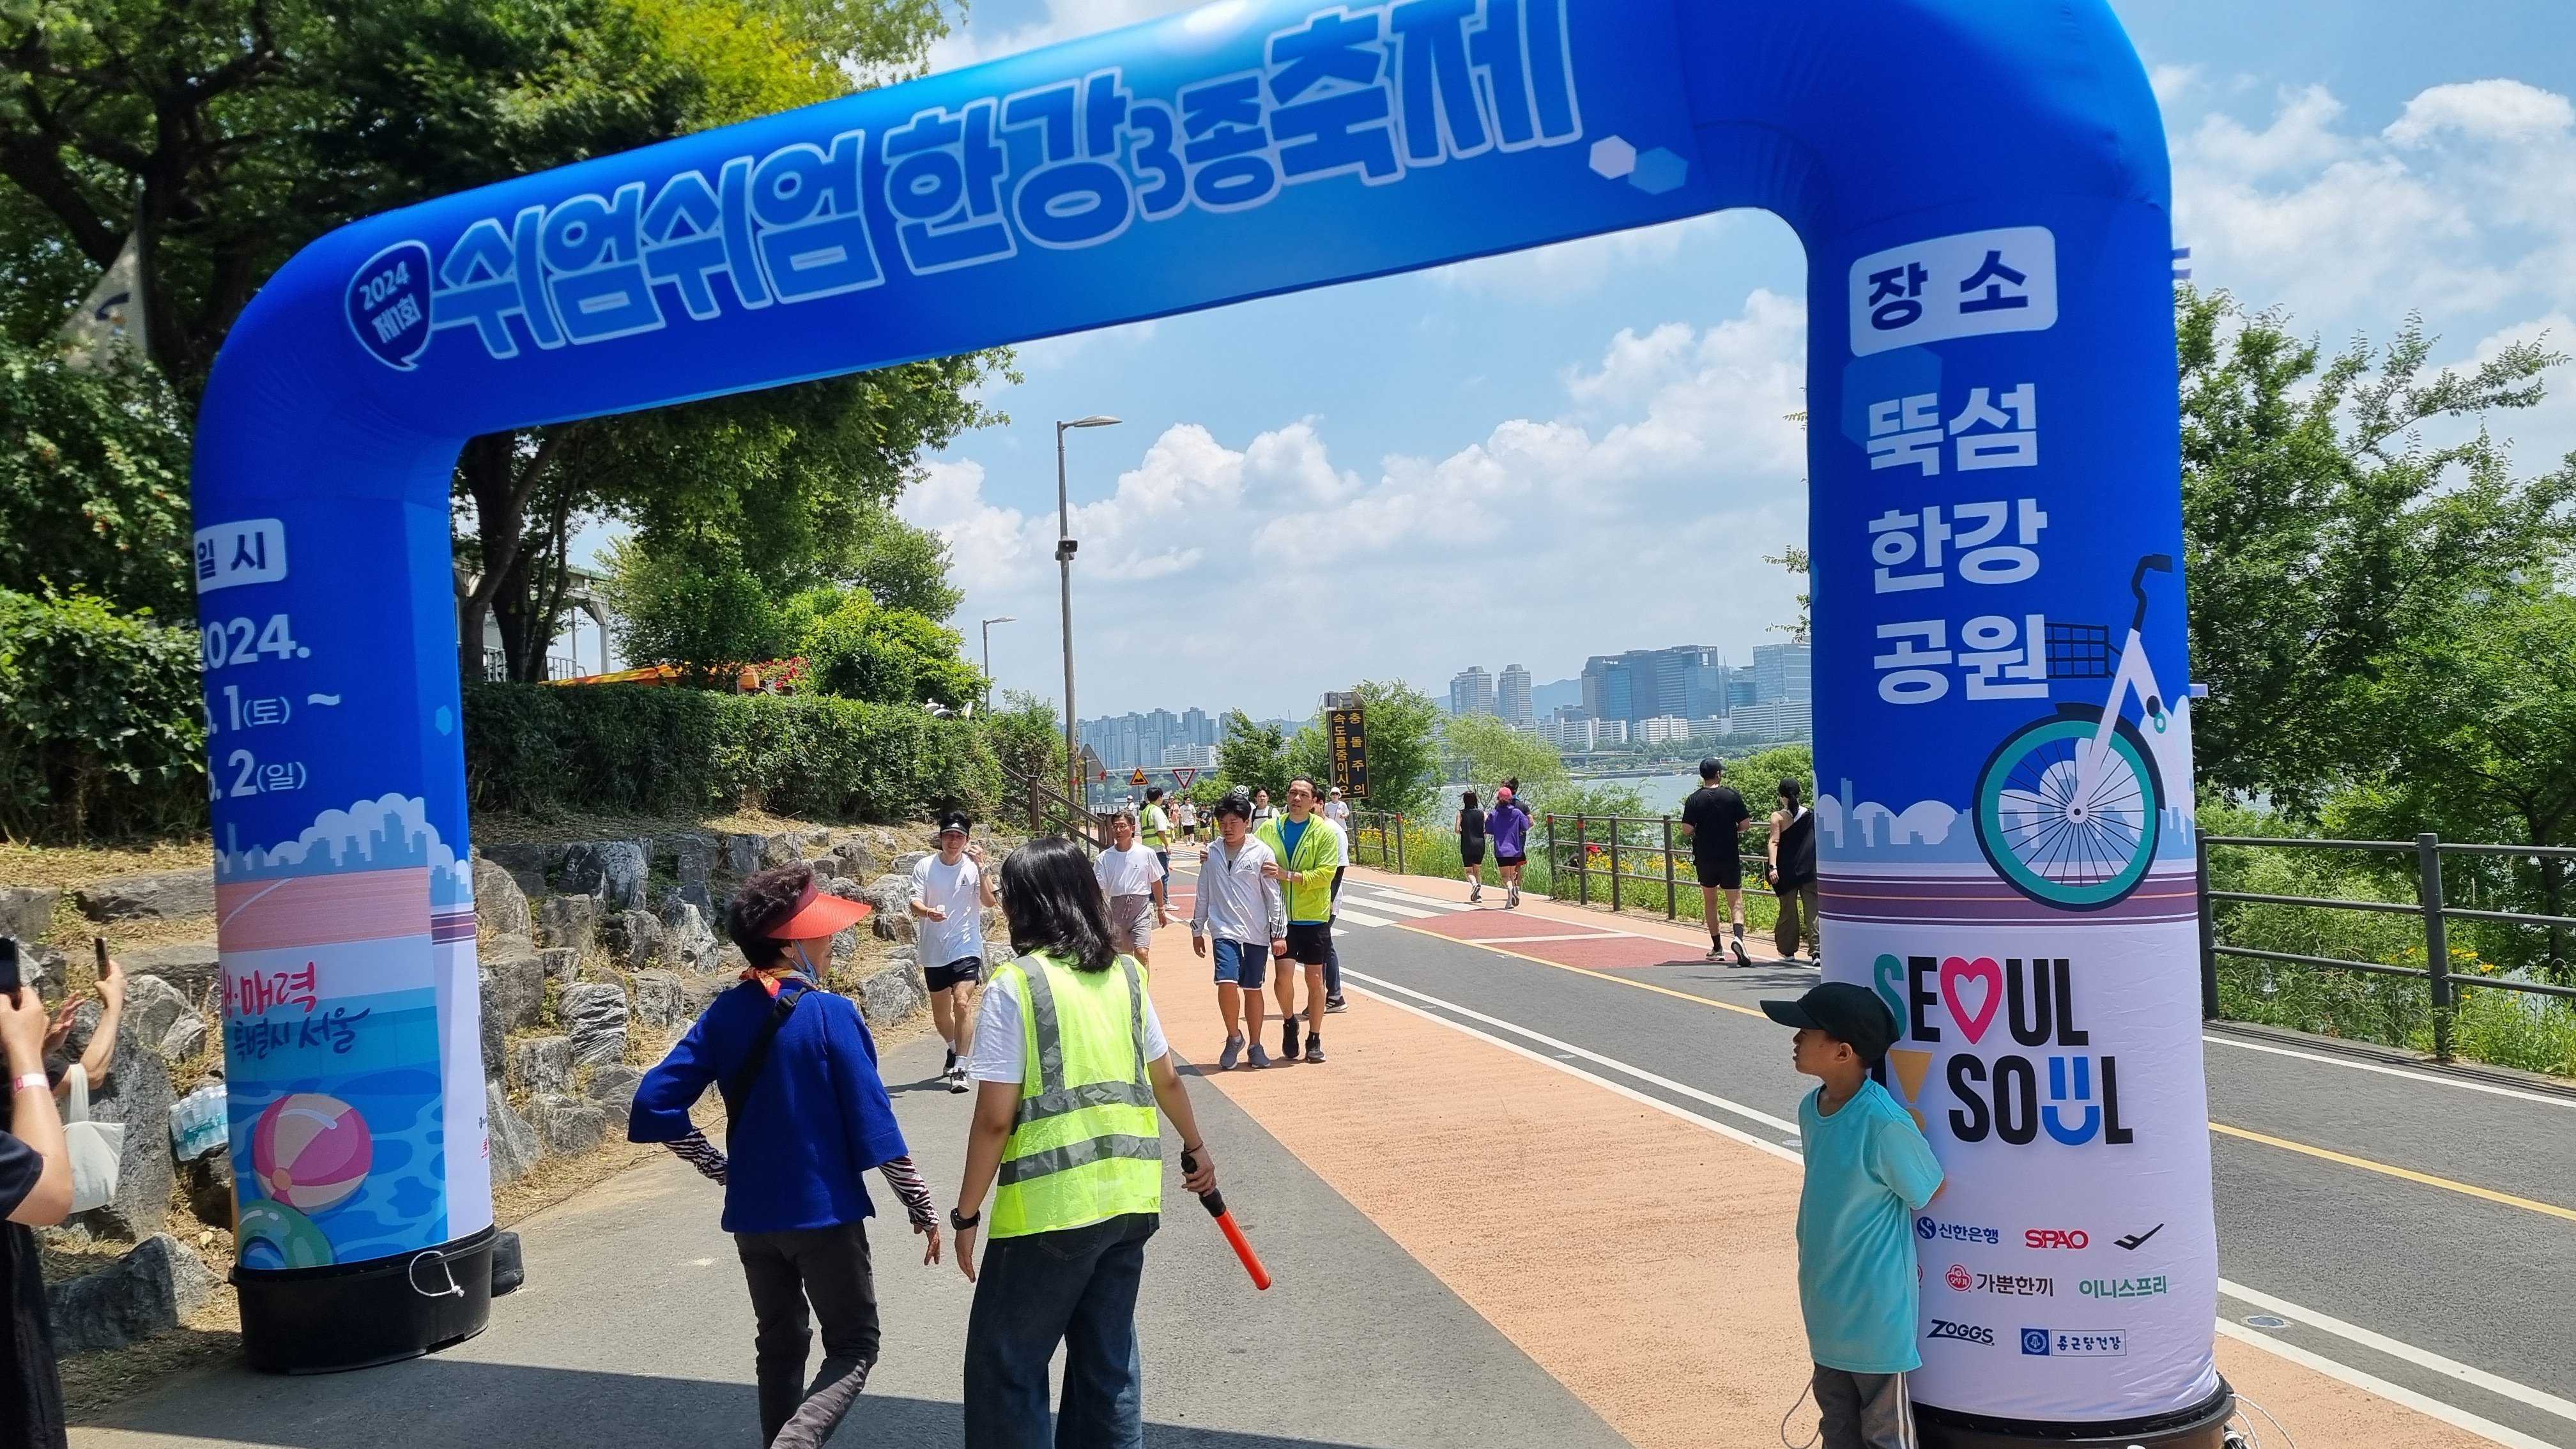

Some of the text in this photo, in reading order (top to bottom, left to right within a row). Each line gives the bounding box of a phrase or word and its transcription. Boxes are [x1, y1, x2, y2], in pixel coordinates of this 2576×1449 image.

[359, 261, 410, 310] 2024
[372, 293, 422, 344] 제1회
[1866, 383, 2038, 477] 뚝섬
[1868, 498, 2048, 594] 한강
[1874, 613, 2049, 705] 공원
[1349, 712, 1365, 795] 충돌주의
[233, 1007, 371, 1063] 특별시 서울
[1946, 1053, 2133, 1146] SOUL
[1938, 1223, 1998, 1245] 신한은행
[2025, 1229, 2089, 1250] SPAO
[1977, 1273, 2053, 1297] 가뿐한끼
[2079, 1276, 2166, 1298] 이니스프리
[1926, 1319, 1994, 1346] ZOGGS
[2057, 1335, 2121, 1351] 종근당건강
